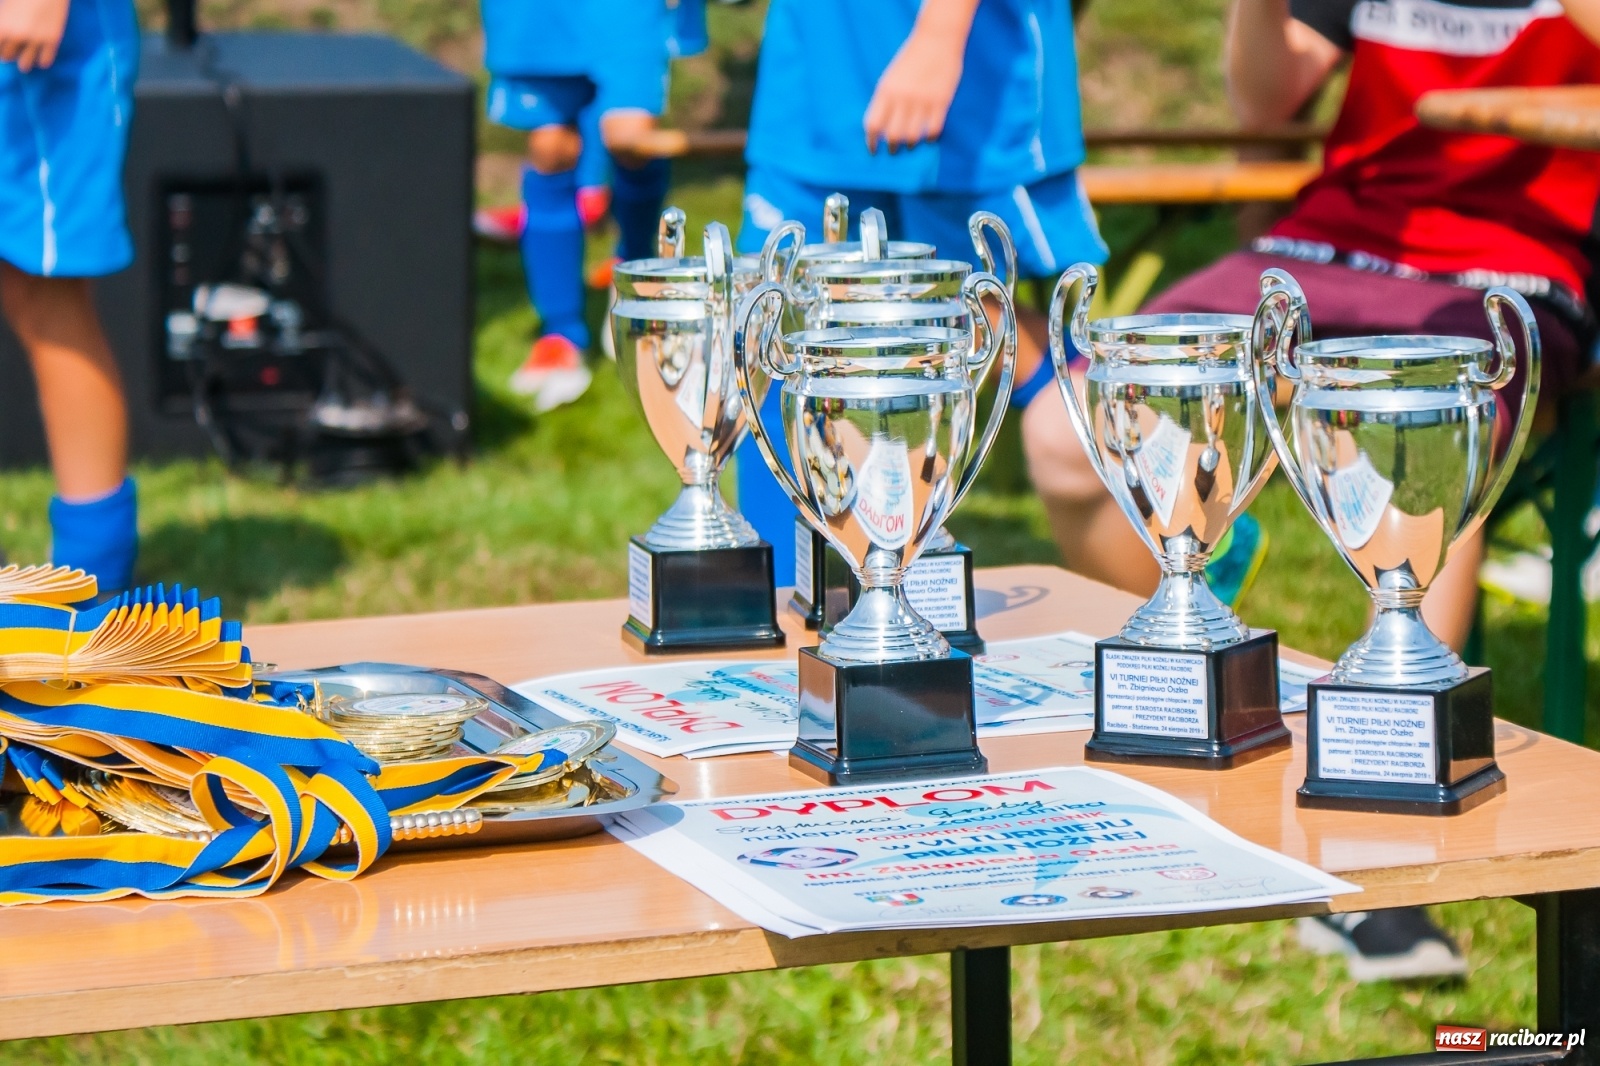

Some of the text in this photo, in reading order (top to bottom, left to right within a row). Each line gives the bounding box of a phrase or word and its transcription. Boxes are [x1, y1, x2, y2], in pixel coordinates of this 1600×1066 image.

[929, 577, 958, 586] NOŻNEJ
[1109, 673, 1199, 687] VI TURNIEJ PIŁKI NOŻNEJ
[1130, 683, 1166, 693] Zbigniewa
[1167, 685, 1189, 694] Oszka
[580, 680, 744, 734] DYPLOM
[1163, 706, 1197, 715] RACIBORSKI
[1135, 714, 1167, 722] PREZYDENT
[1167, 715, 1199, 724] RACIBORZA
[1326, 716, 1426, 729] VI TURNIEJ PIŁKI NOŻNEJ
[1106, 721, 1128, 729] Racibórz
[1132, 723, 1160, 732] Studzienna,
[1168, 726, 1188, 734] sierpnia
[1335, 726, 1415, 737] im. Zbigniewa Oszka
[1354, 749, 1386, 757] STAROSTA
[1386, 750, 1424, 759] RACIBORSKI
[1354, 758, 1390, 767] PREZYDENT
[1390, 760, 1426, 769] RACIBORZA
[1322, 767, 1347, 775] Racibórz
[709, 780, 1056, 821] DYPLOM
[743, 801, 1107, 843] najlepszego zawodnika
[855, 811, 1109, 843] PODOKRĘGU RYBNIK
[880, 818, 1135, 851] w VI TURNIEJU
[903, 830, 1148, 860] PIŁKI NOŻNEJ
[805, 843, 1181, 880] im. Zbigniewa Oszka
[803, 873, 902, 888] reprezentacji
[853, 886, 928, 898] STAROSTA
[931, 878, 1024, 891] RACIBORSKI
[1034, 868, 1123, 881] PREZYDENT
[1126, 862, 1207, 874] RACIBORZA
